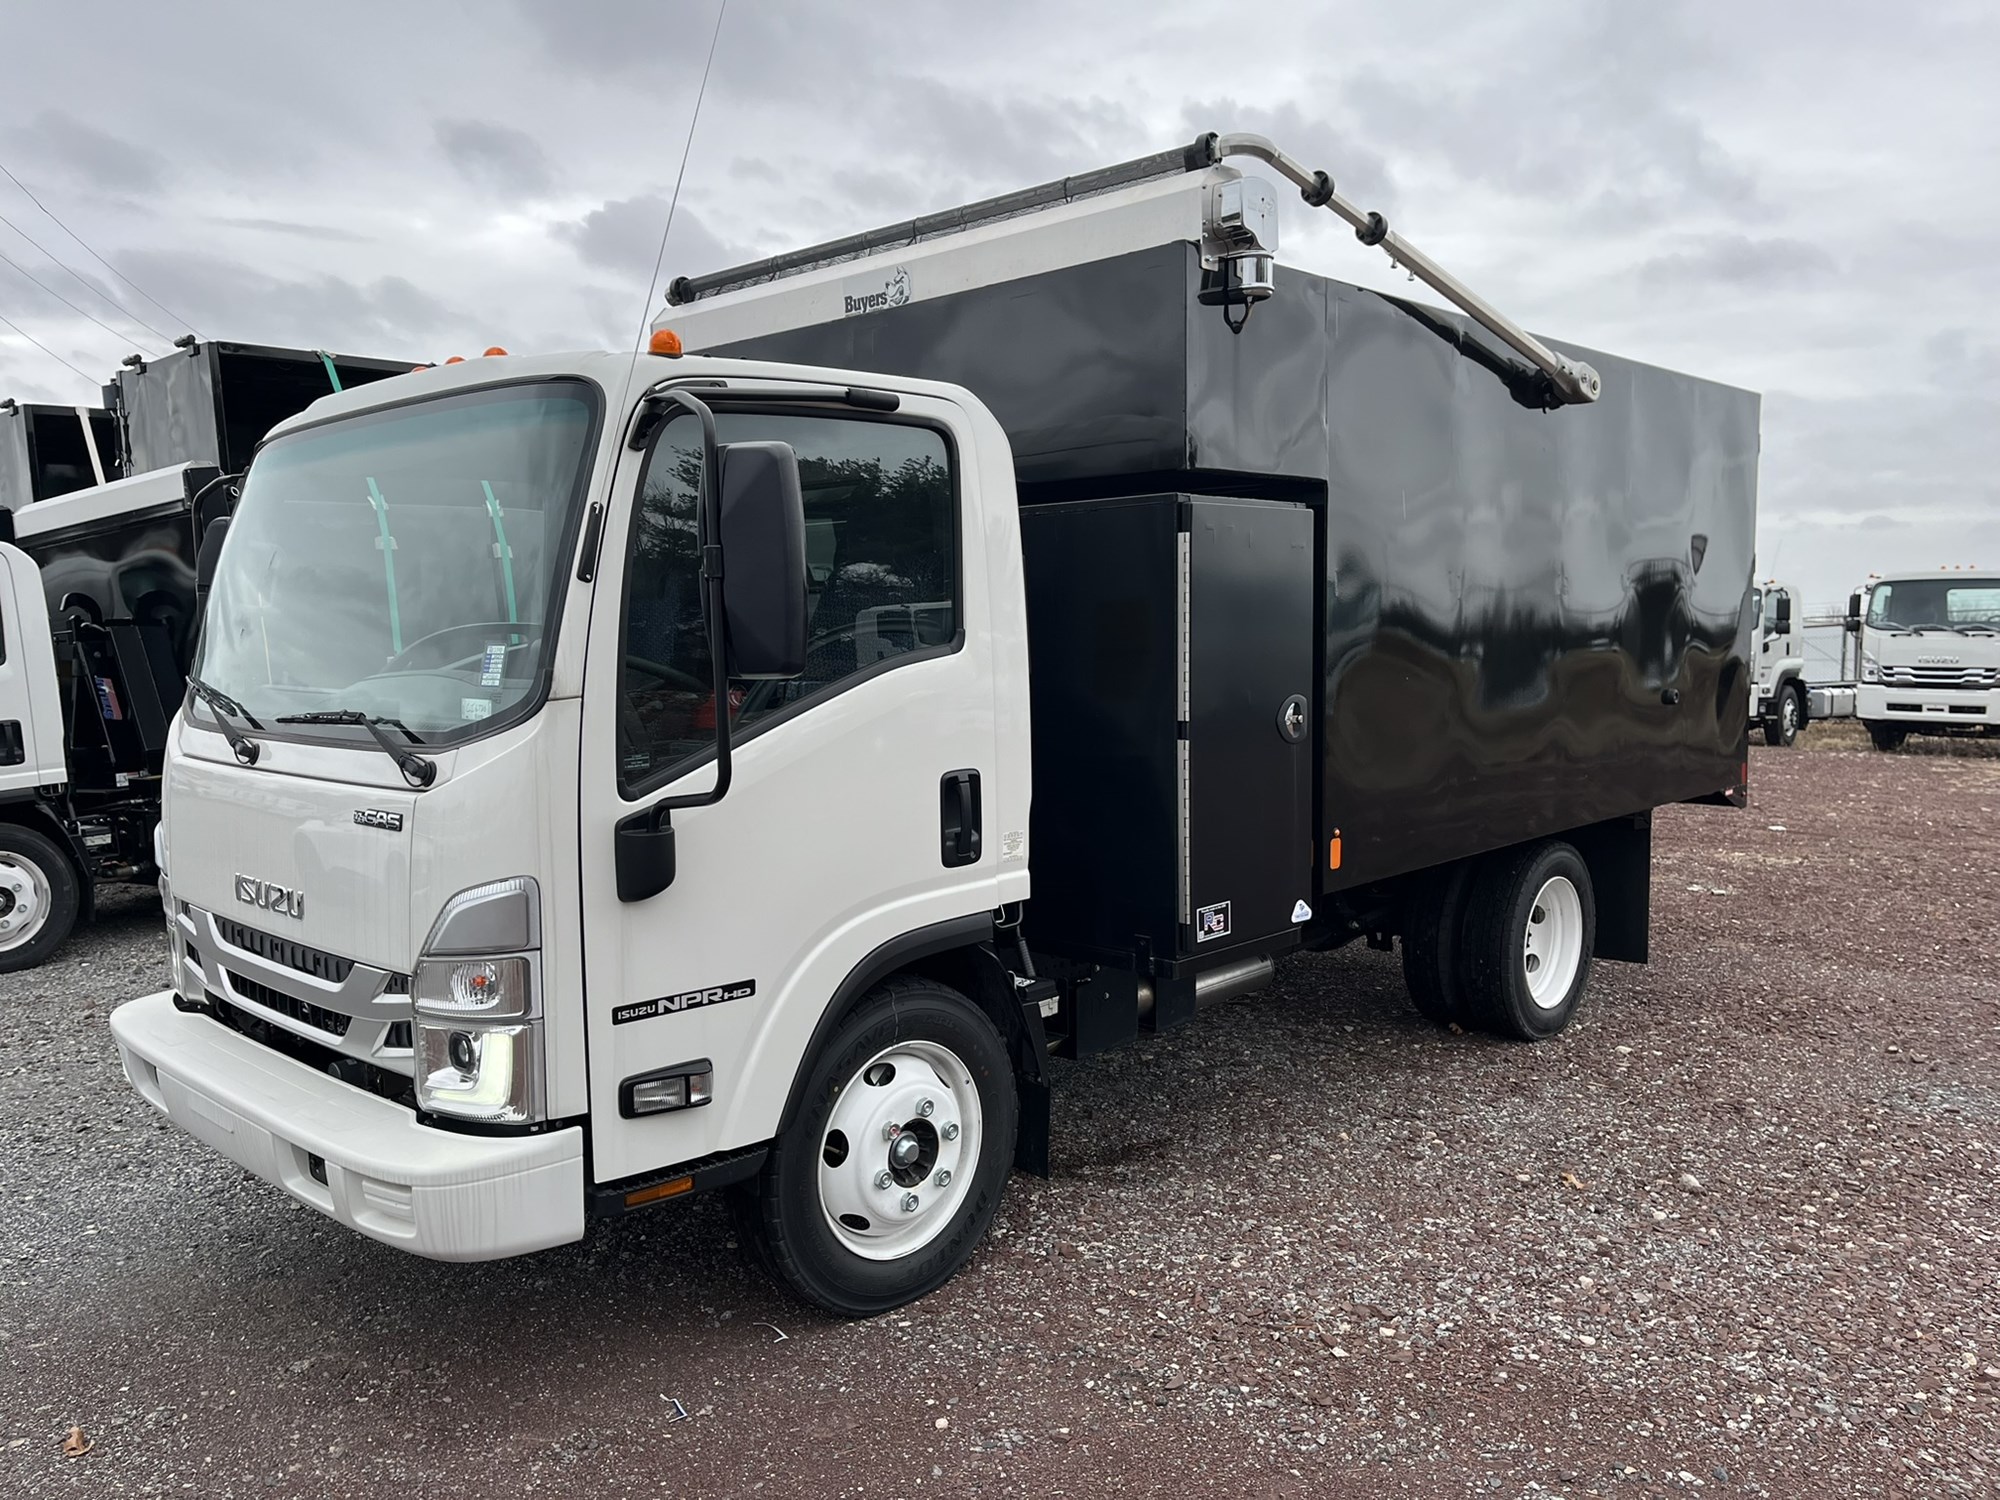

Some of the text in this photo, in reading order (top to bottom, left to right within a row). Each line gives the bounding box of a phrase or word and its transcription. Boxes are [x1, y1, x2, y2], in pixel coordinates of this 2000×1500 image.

[844, 292, 888, 313] Buyers
[1918, 655, 1959, 664] ISUZU
[235, 872, 304, 920] ISUZU
[617, 988, 751, 1020] ISUZU NPR HD
